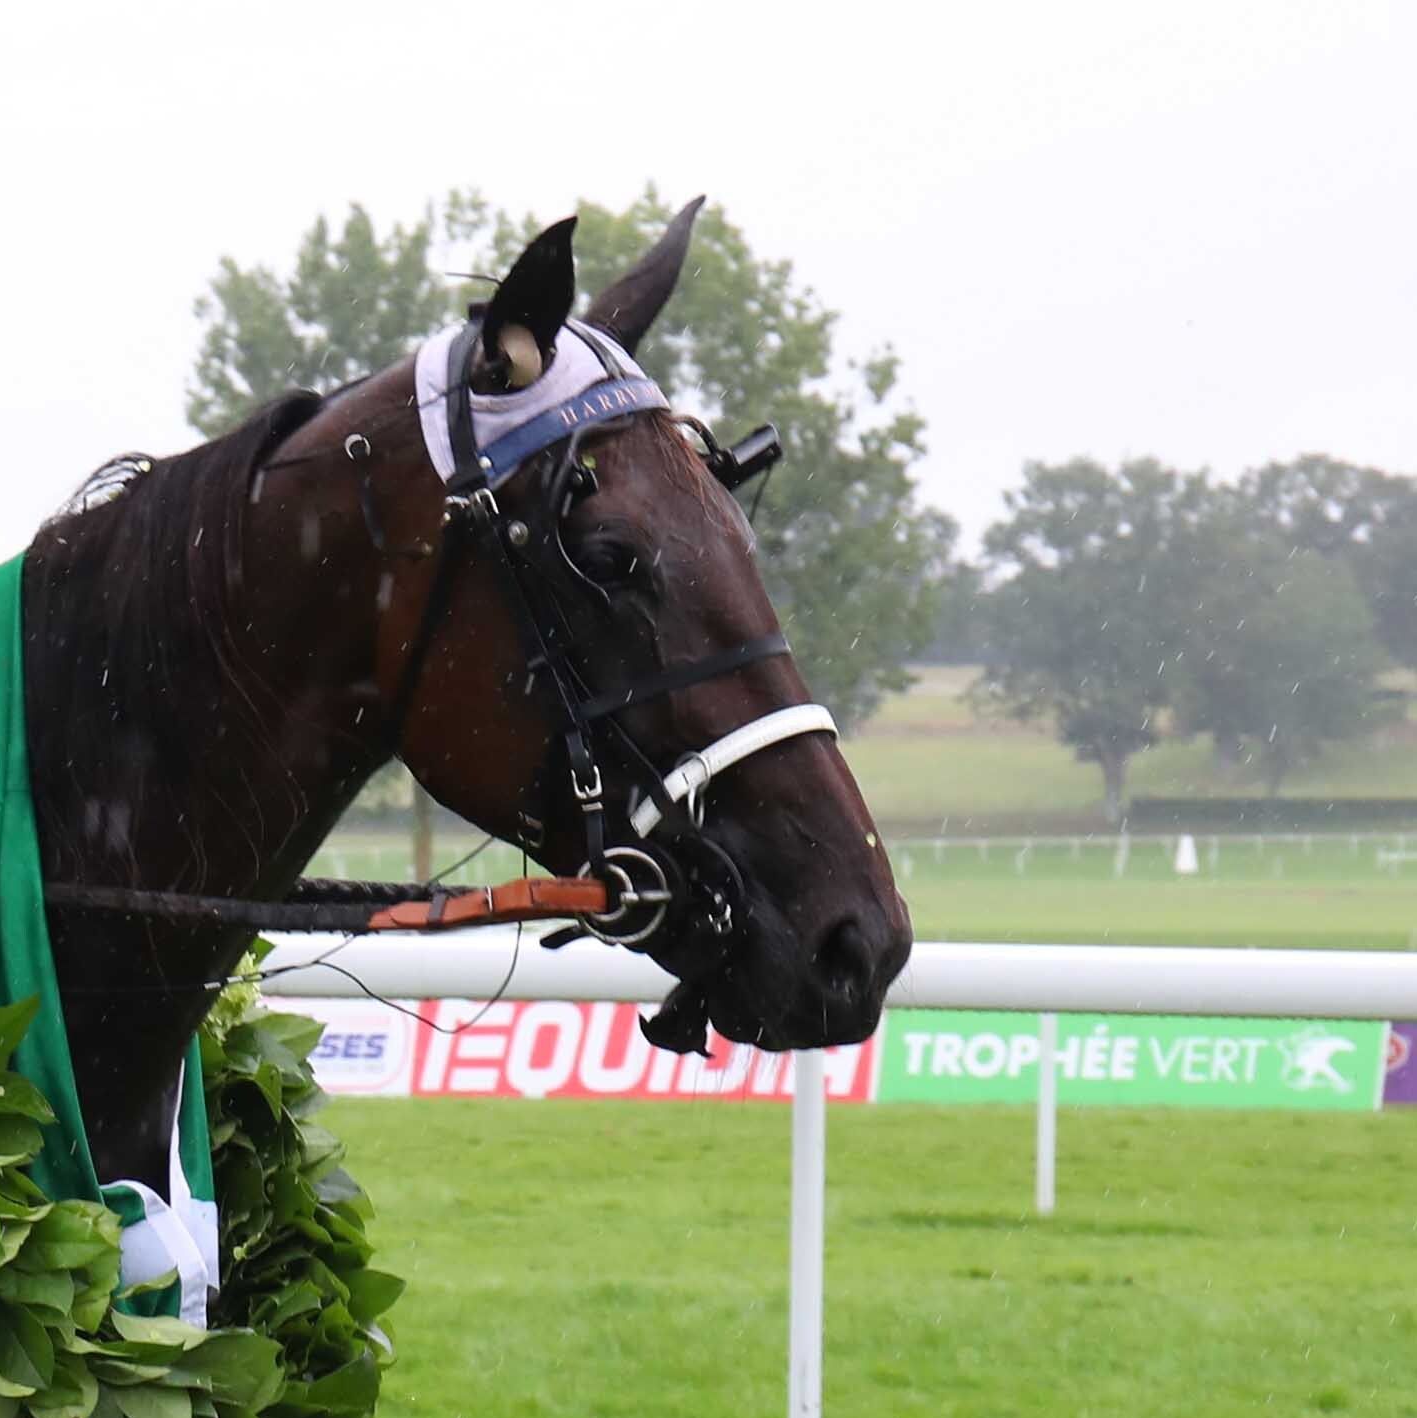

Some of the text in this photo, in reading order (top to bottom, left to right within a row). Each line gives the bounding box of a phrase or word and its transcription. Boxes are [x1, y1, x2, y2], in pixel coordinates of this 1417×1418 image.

[312, 1034, 387, 1059] SES
[903, 1025, 1267, 1084] TROPHÉE VERT
